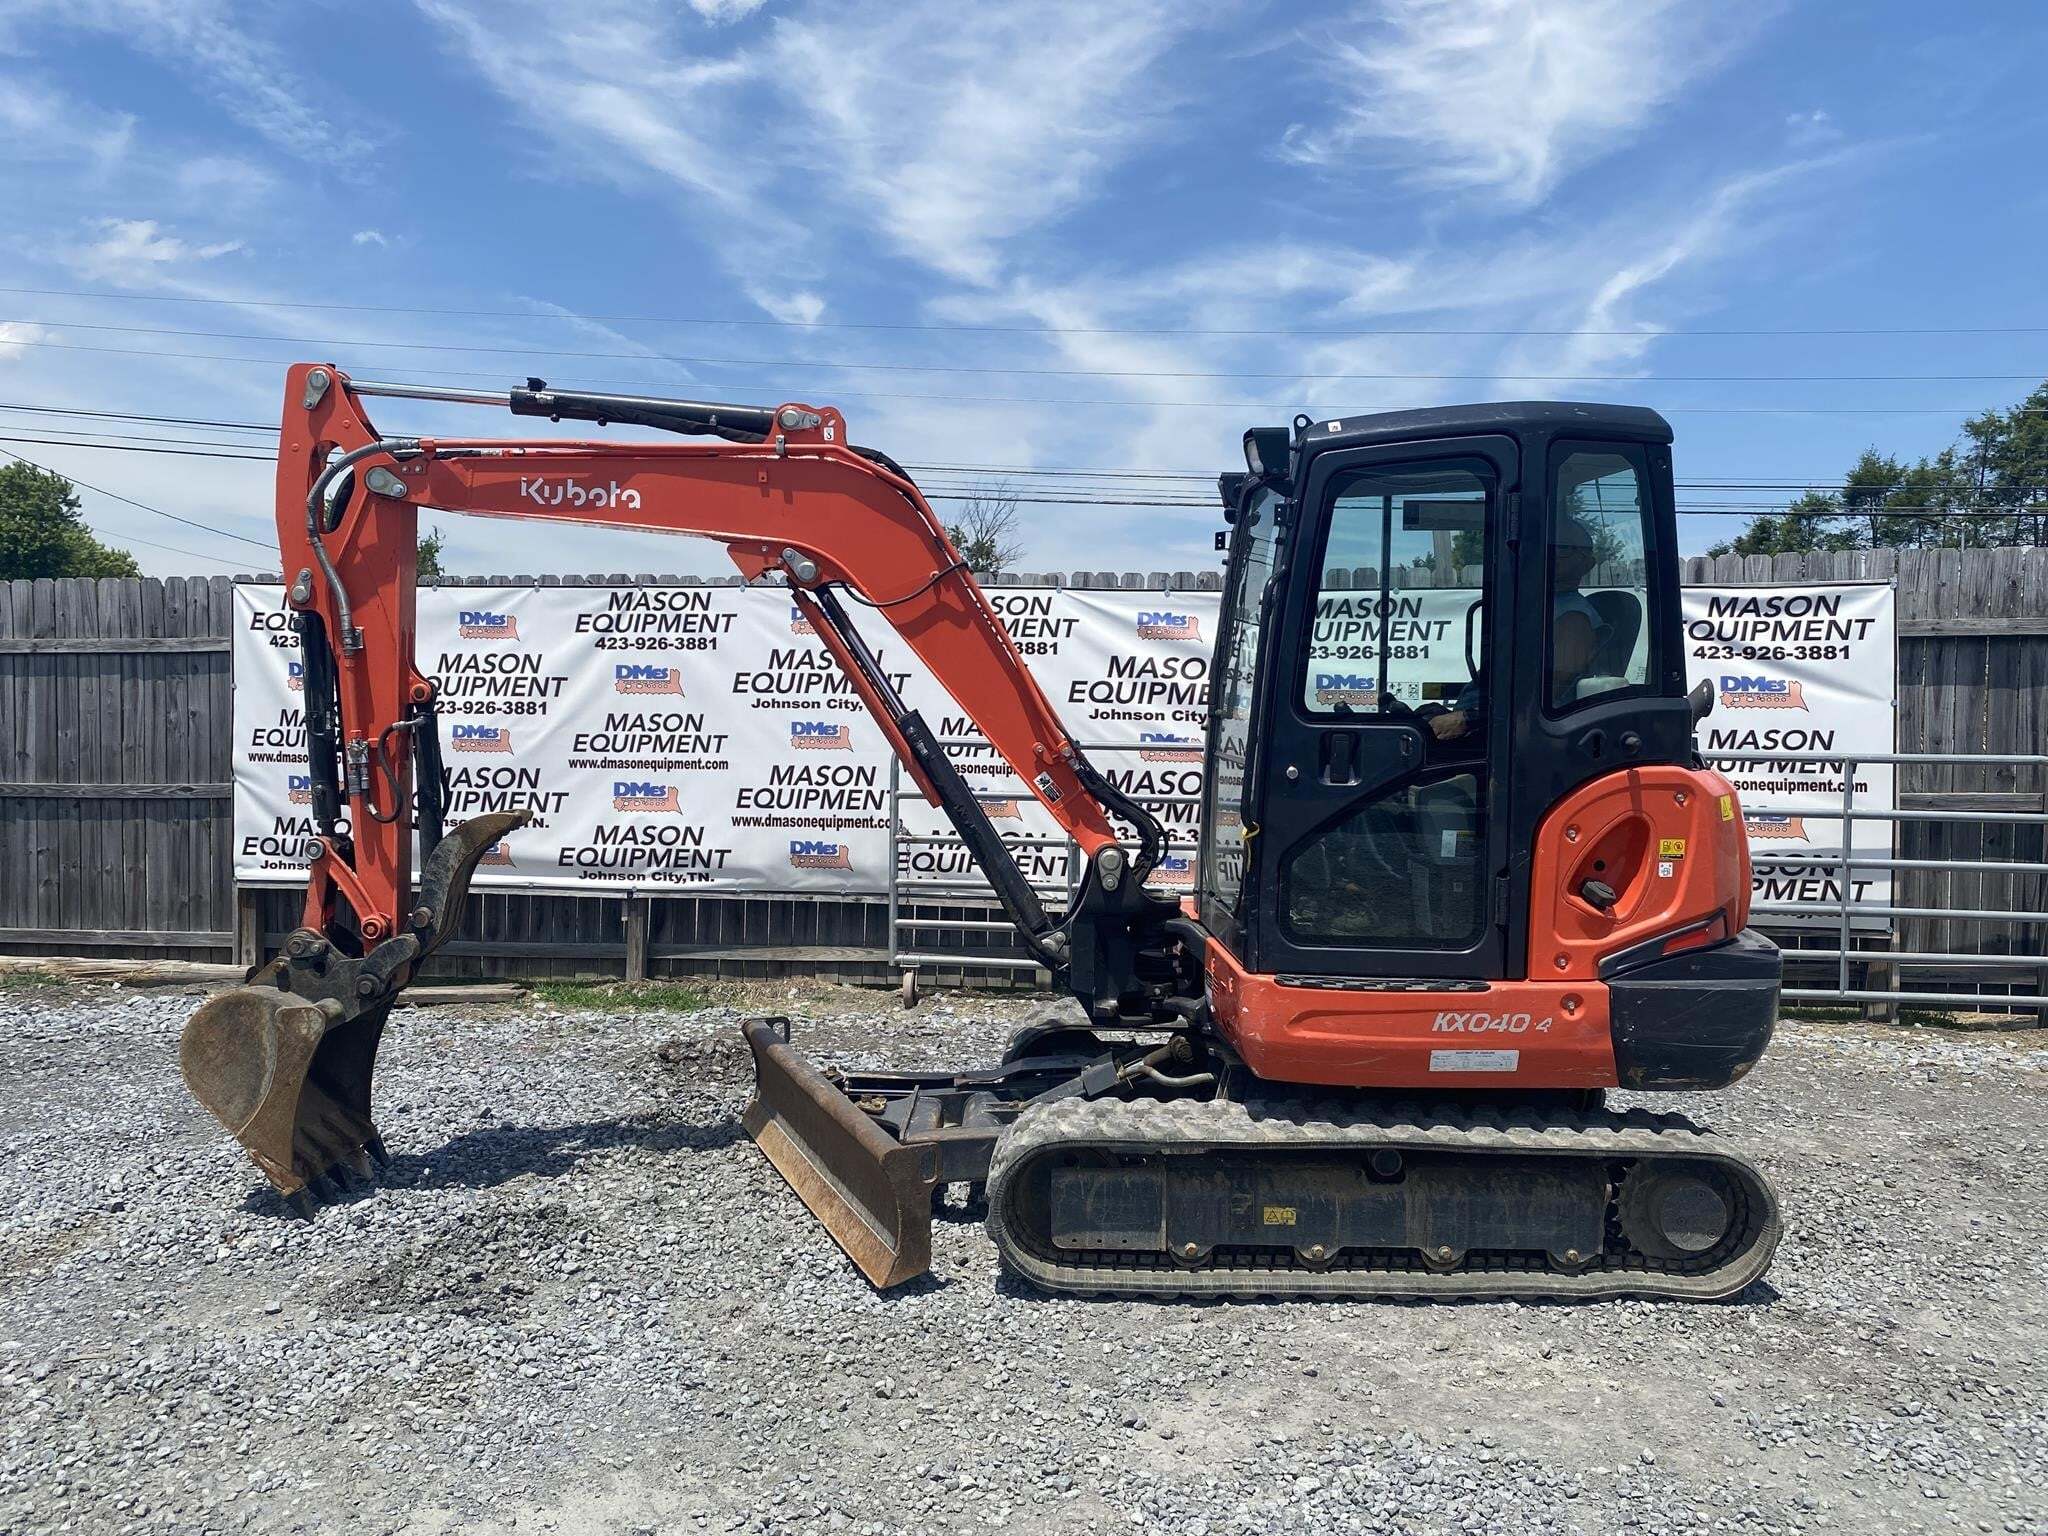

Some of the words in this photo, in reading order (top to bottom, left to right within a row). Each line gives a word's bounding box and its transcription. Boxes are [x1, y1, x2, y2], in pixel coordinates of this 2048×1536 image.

[520, 476, 641, 509] Kubota
[607, 591, 712, 612] MASON
[1707, 595, 1842, 618] MASON
[575, 613, 738, 634] EQUIPMENT
[1683, 618, 1876, 642] QUIPMENT
[594, 636, 718, 651] 423-926-3881
[1692, 645, 1851, 660] 423-926-3881
[437, 653, 543, 675] MASON
[1107, 655, 1211, 681] MASO
[751, 698, 821, 710] Johnson
[1089, 708, 1165, 721] Johnson
[604, 713, 705, 733] MASON
[572, 734, 729, 754] EQUIPMENT
[1707, 729, 1836, 751] MASON
[568, 757, 729, 773] www.dmasonequipment.com
[769, 765, 877, 787] MASON
[736, 788, 891, 811] EQUIPMEN
[731, 814, 903, 831] www.dmasonequipment.co
[592, 825, 705, 847] MASON
[558, 847, 732, 870] EQUIPMENT
[578, 870, 646, 882] Johnson
[651, 871, 715, 884] City,TN.
